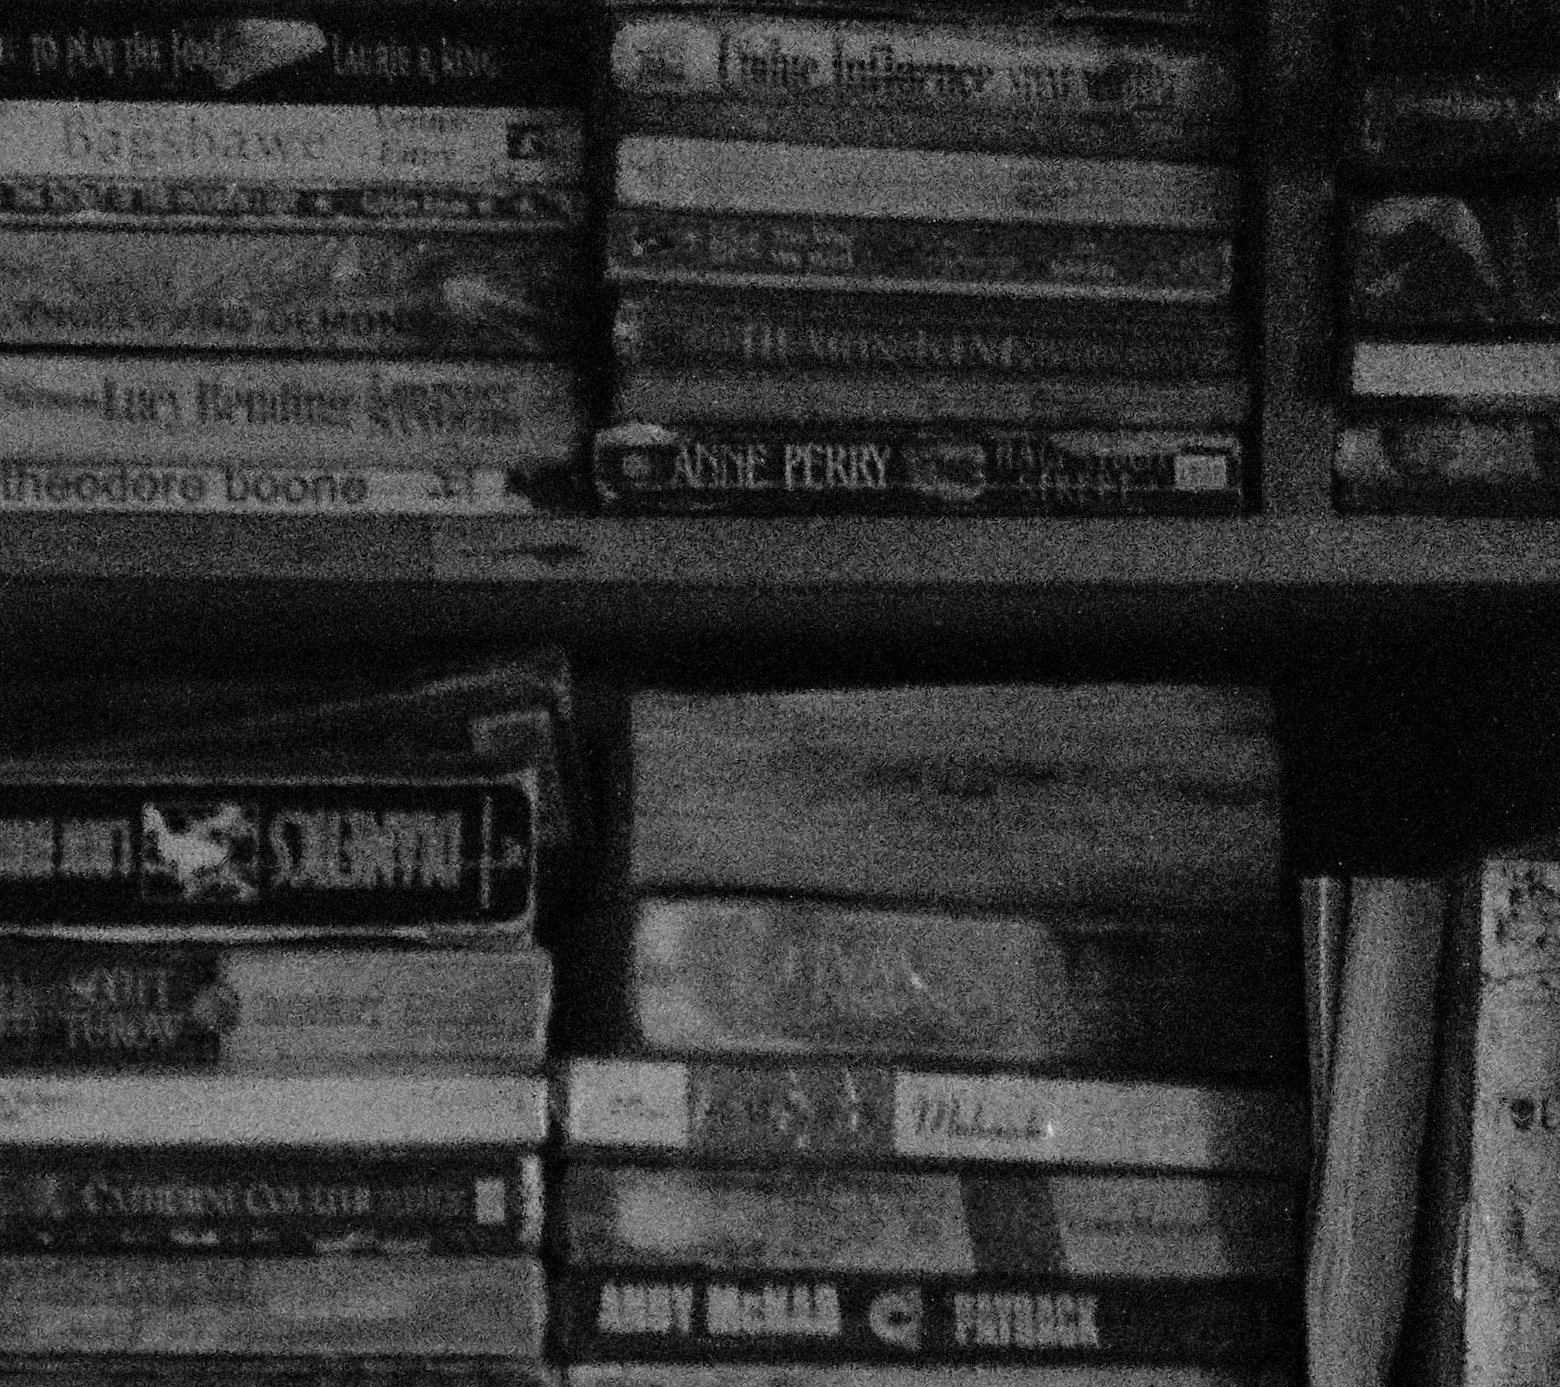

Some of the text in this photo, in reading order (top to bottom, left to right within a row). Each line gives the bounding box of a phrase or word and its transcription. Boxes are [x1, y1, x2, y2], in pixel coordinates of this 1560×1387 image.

[1, 462, 369, 503] theodore boone
[673, 443, 893, 490] ANNE PERRY
[599, 1284, 694, 1334] ANDY
[953, 1291, 1102, 1347] PAYBACK
